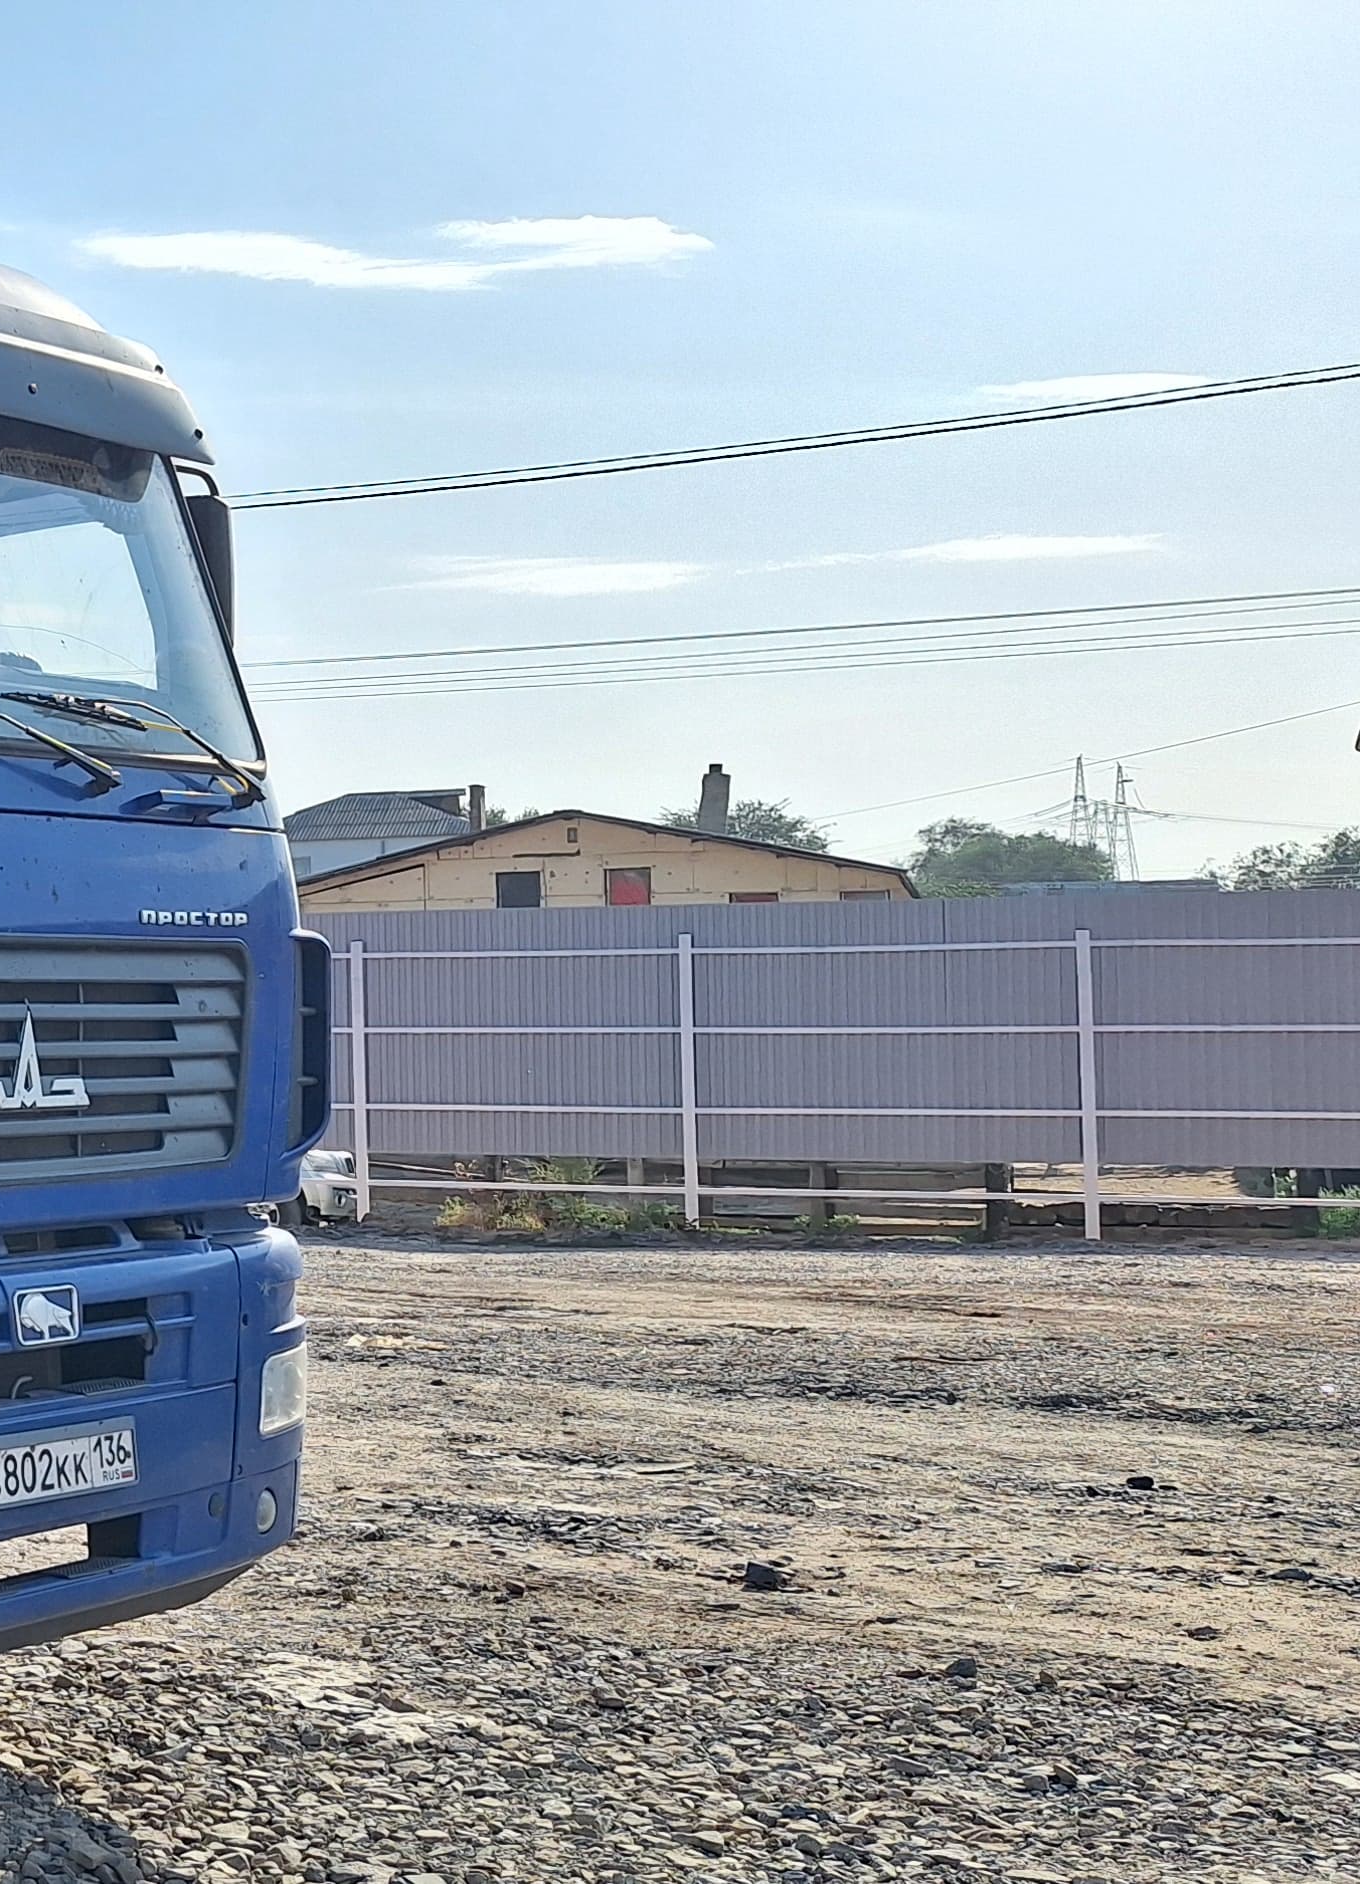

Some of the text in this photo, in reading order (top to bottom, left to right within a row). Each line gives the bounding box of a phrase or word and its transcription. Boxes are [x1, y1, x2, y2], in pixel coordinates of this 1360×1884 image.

[141, 909, 248, 926] ПРОСТОР
[93, 1433, 127, 1468] 136
[102, 1470, 121, 1481] RUS
